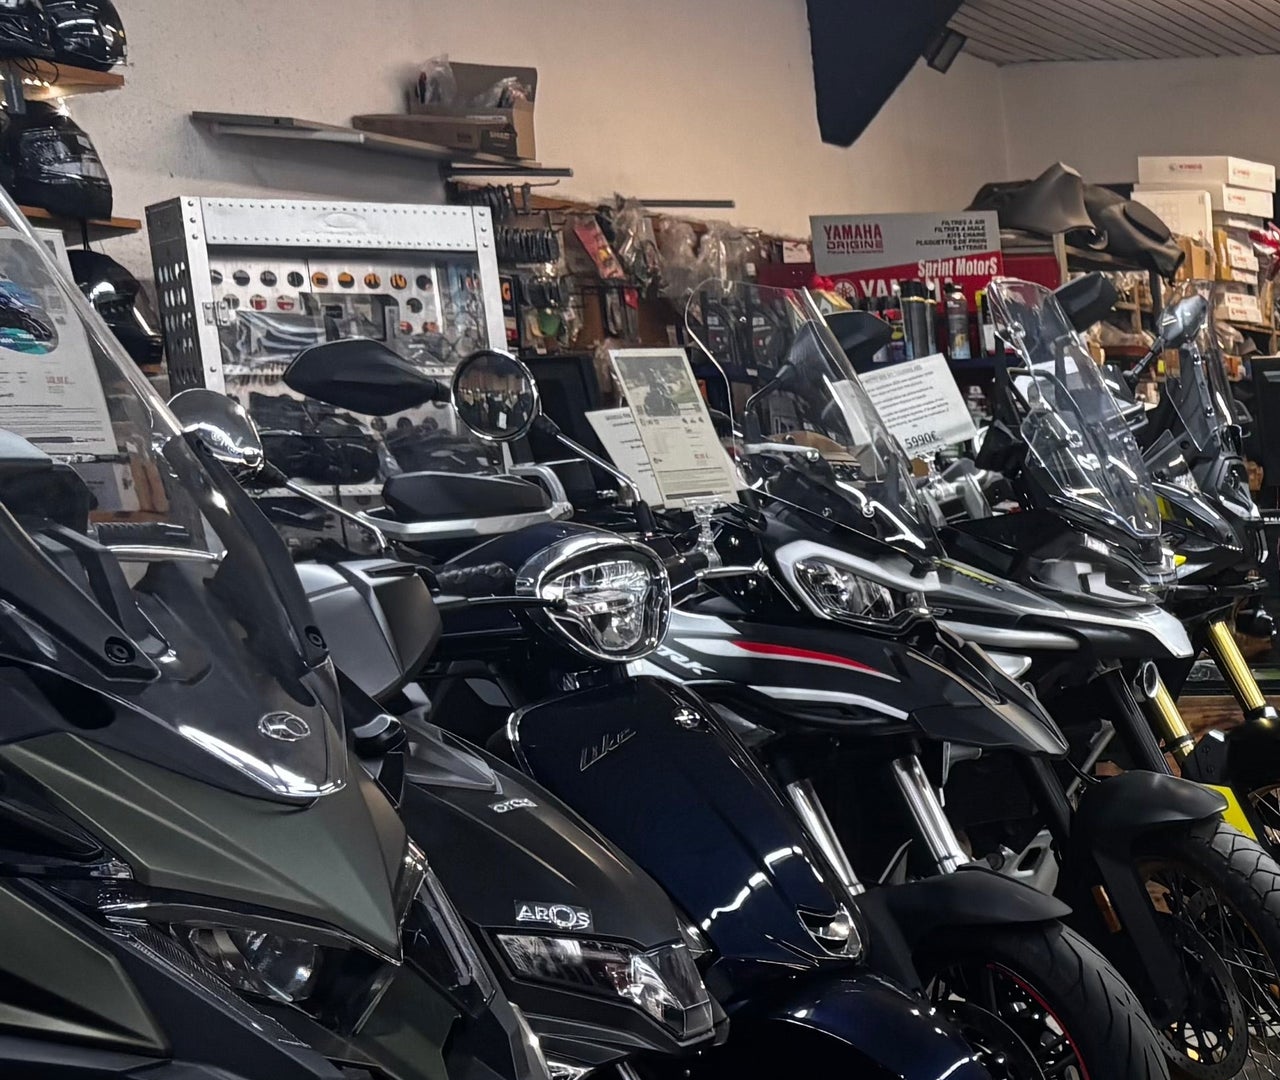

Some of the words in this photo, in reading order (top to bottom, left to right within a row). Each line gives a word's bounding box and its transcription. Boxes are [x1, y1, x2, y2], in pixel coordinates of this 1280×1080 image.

[824, 224, 882, 240] YAMAHA
[917, 259, 953, 279] Sprint
[904, 430, 941, 450] 5990€
